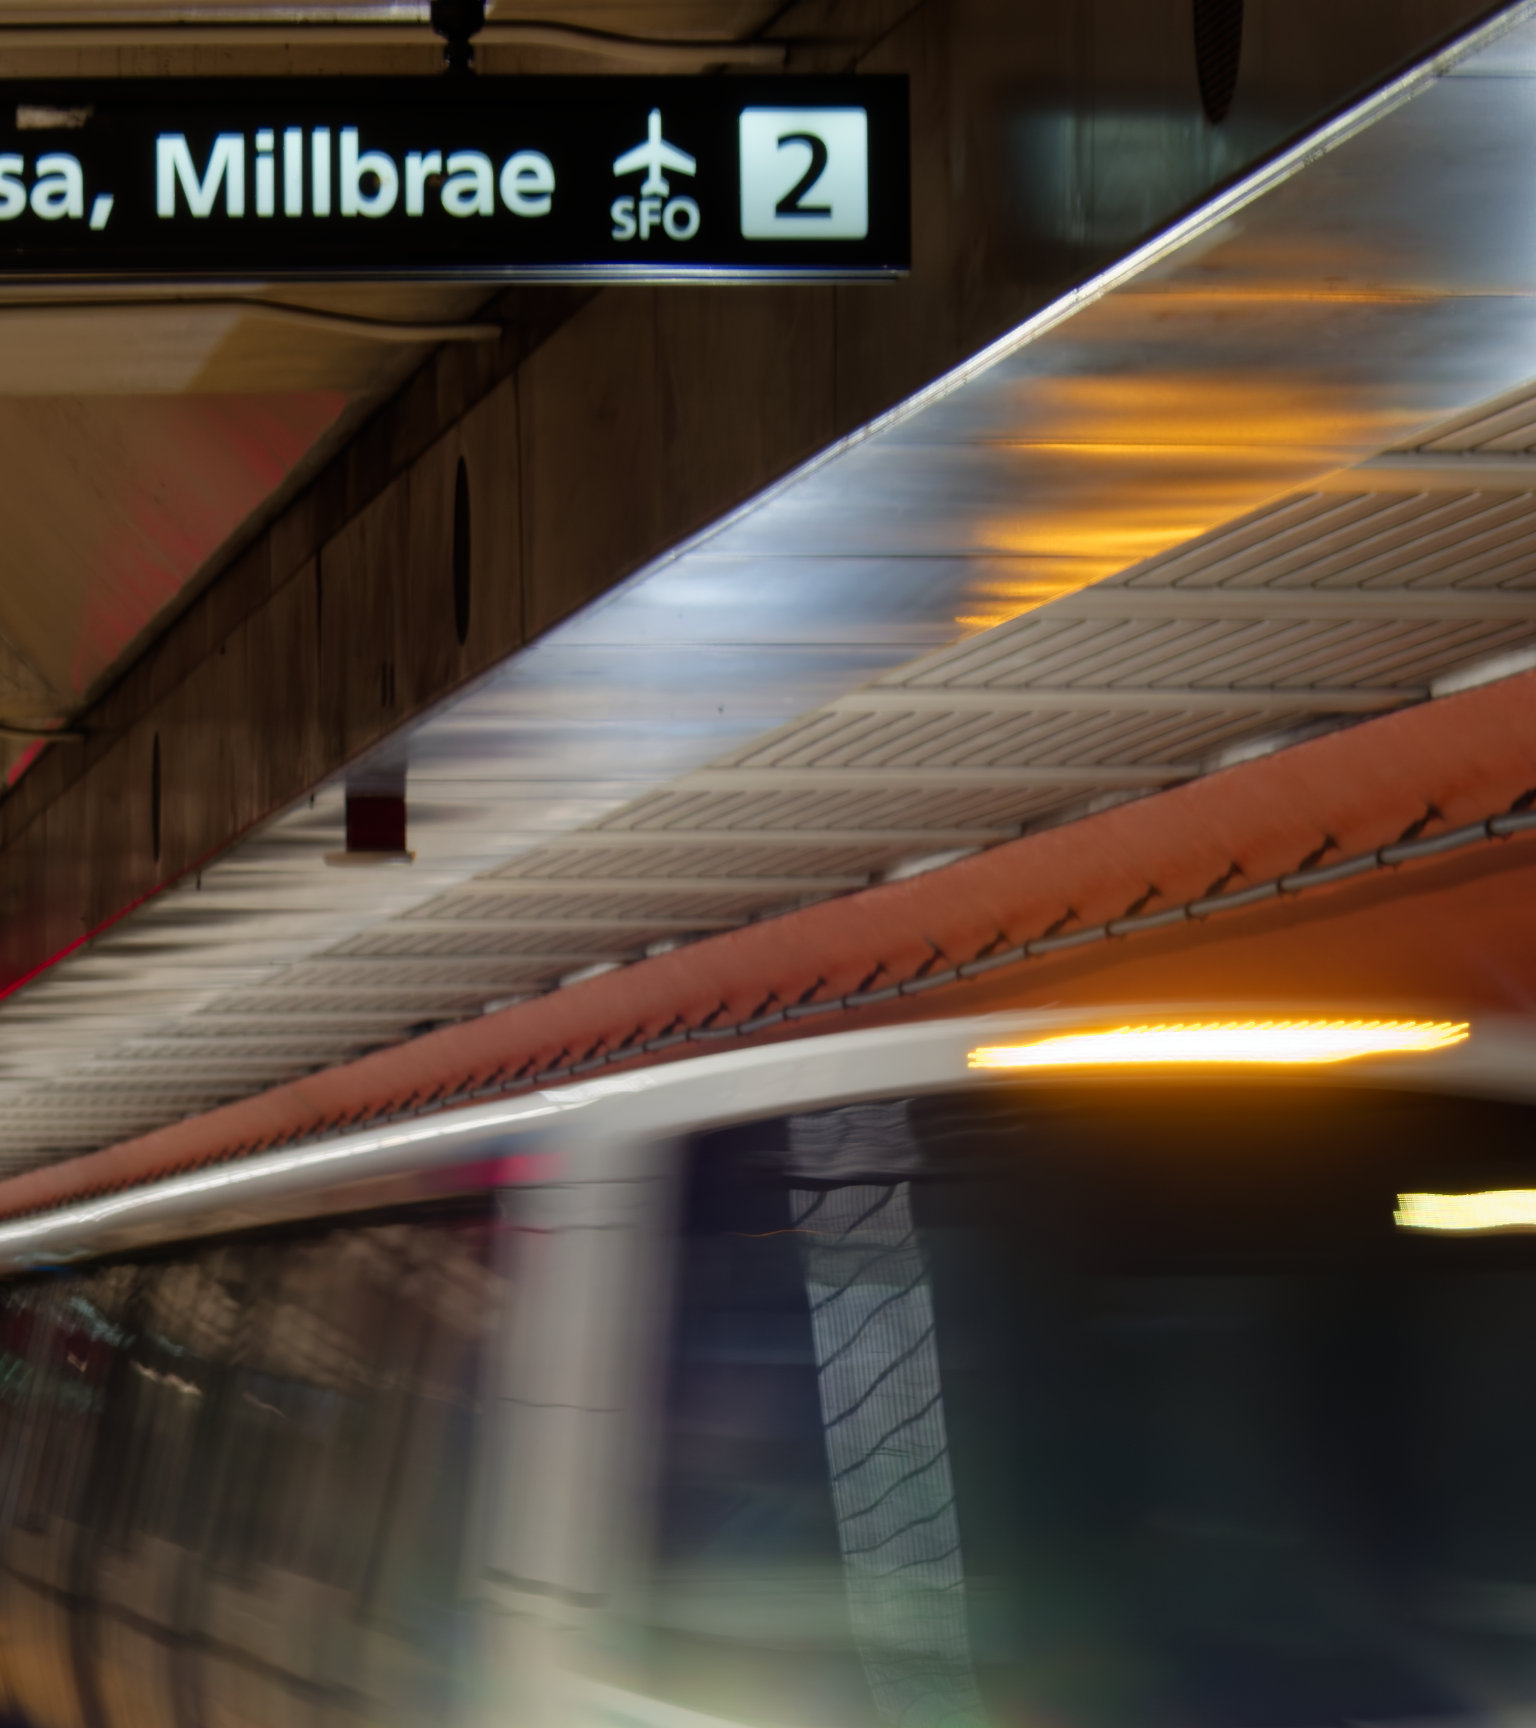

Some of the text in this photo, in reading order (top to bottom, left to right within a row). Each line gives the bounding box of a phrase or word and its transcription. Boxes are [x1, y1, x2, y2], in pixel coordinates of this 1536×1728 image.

[155, 130, 556, 216] Millbrae
[609, 199, 701, 239] SFO
[775, 132, 833, 217] 2
